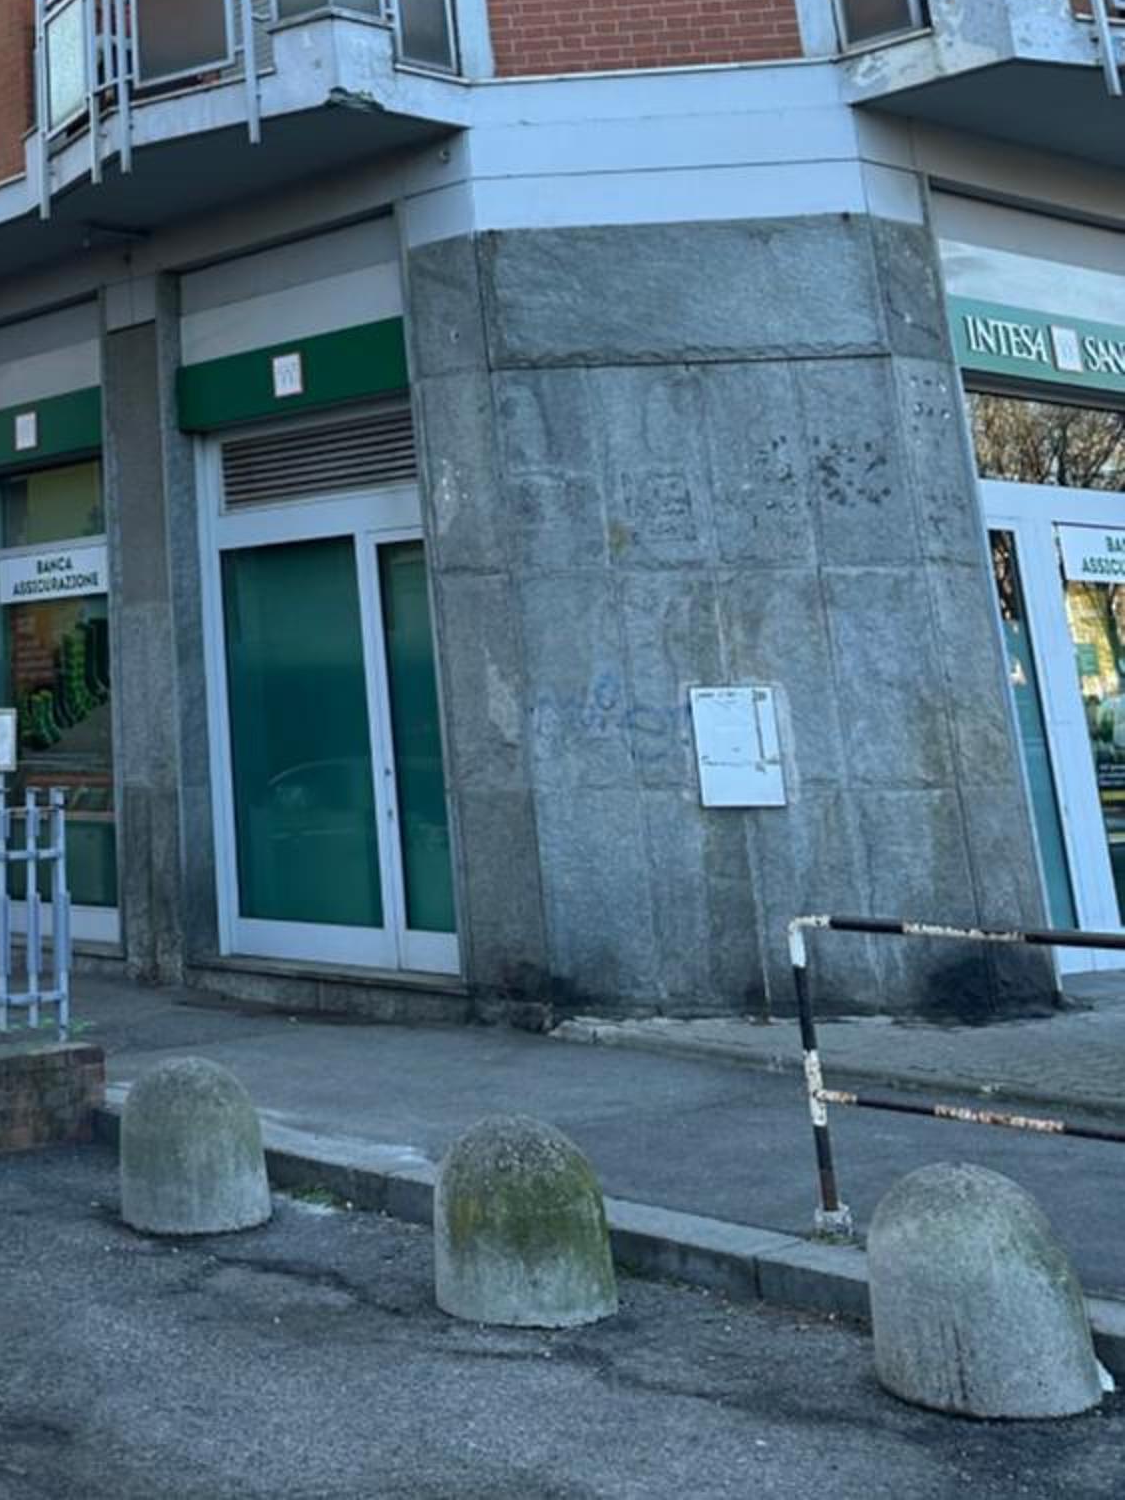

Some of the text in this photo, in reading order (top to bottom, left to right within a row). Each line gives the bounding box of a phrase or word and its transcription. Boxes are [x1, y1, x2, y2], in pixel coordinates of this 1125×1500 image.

[964, 314, 1049, 363] INTESA
[36, 556, 73, 574] BANCA
[12, 571, 99, 596] ASSICURAZIONE
